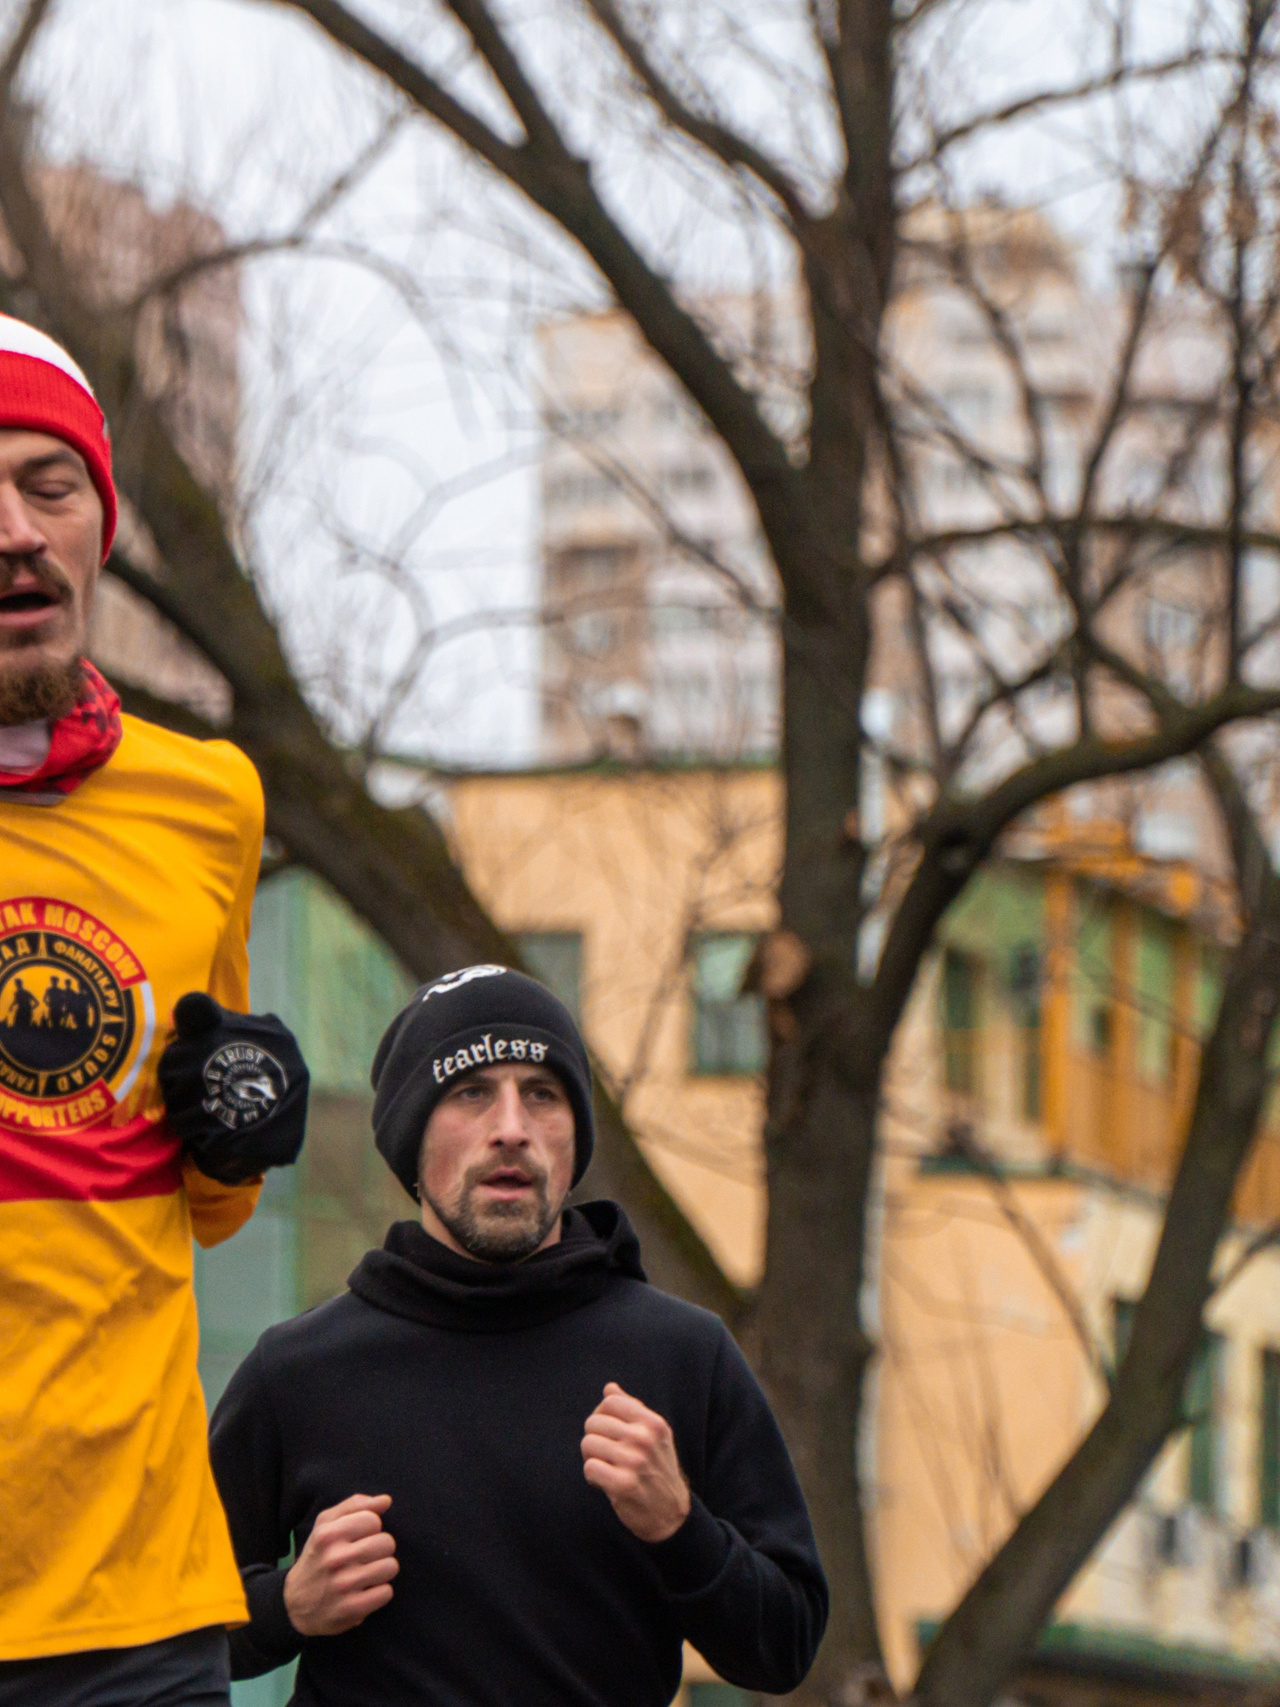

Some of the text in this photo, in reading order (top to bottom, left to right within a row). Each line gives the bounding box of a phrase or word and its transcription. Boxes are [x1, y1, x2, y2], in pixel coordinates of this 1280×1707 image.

[44, 903, 140, 981] MOSCOW
[56, 1034, 117, 1092] SQUAD
[215, 1047, 264, 1067] TRUST
[432, 1032, 550, 1083] fearless
